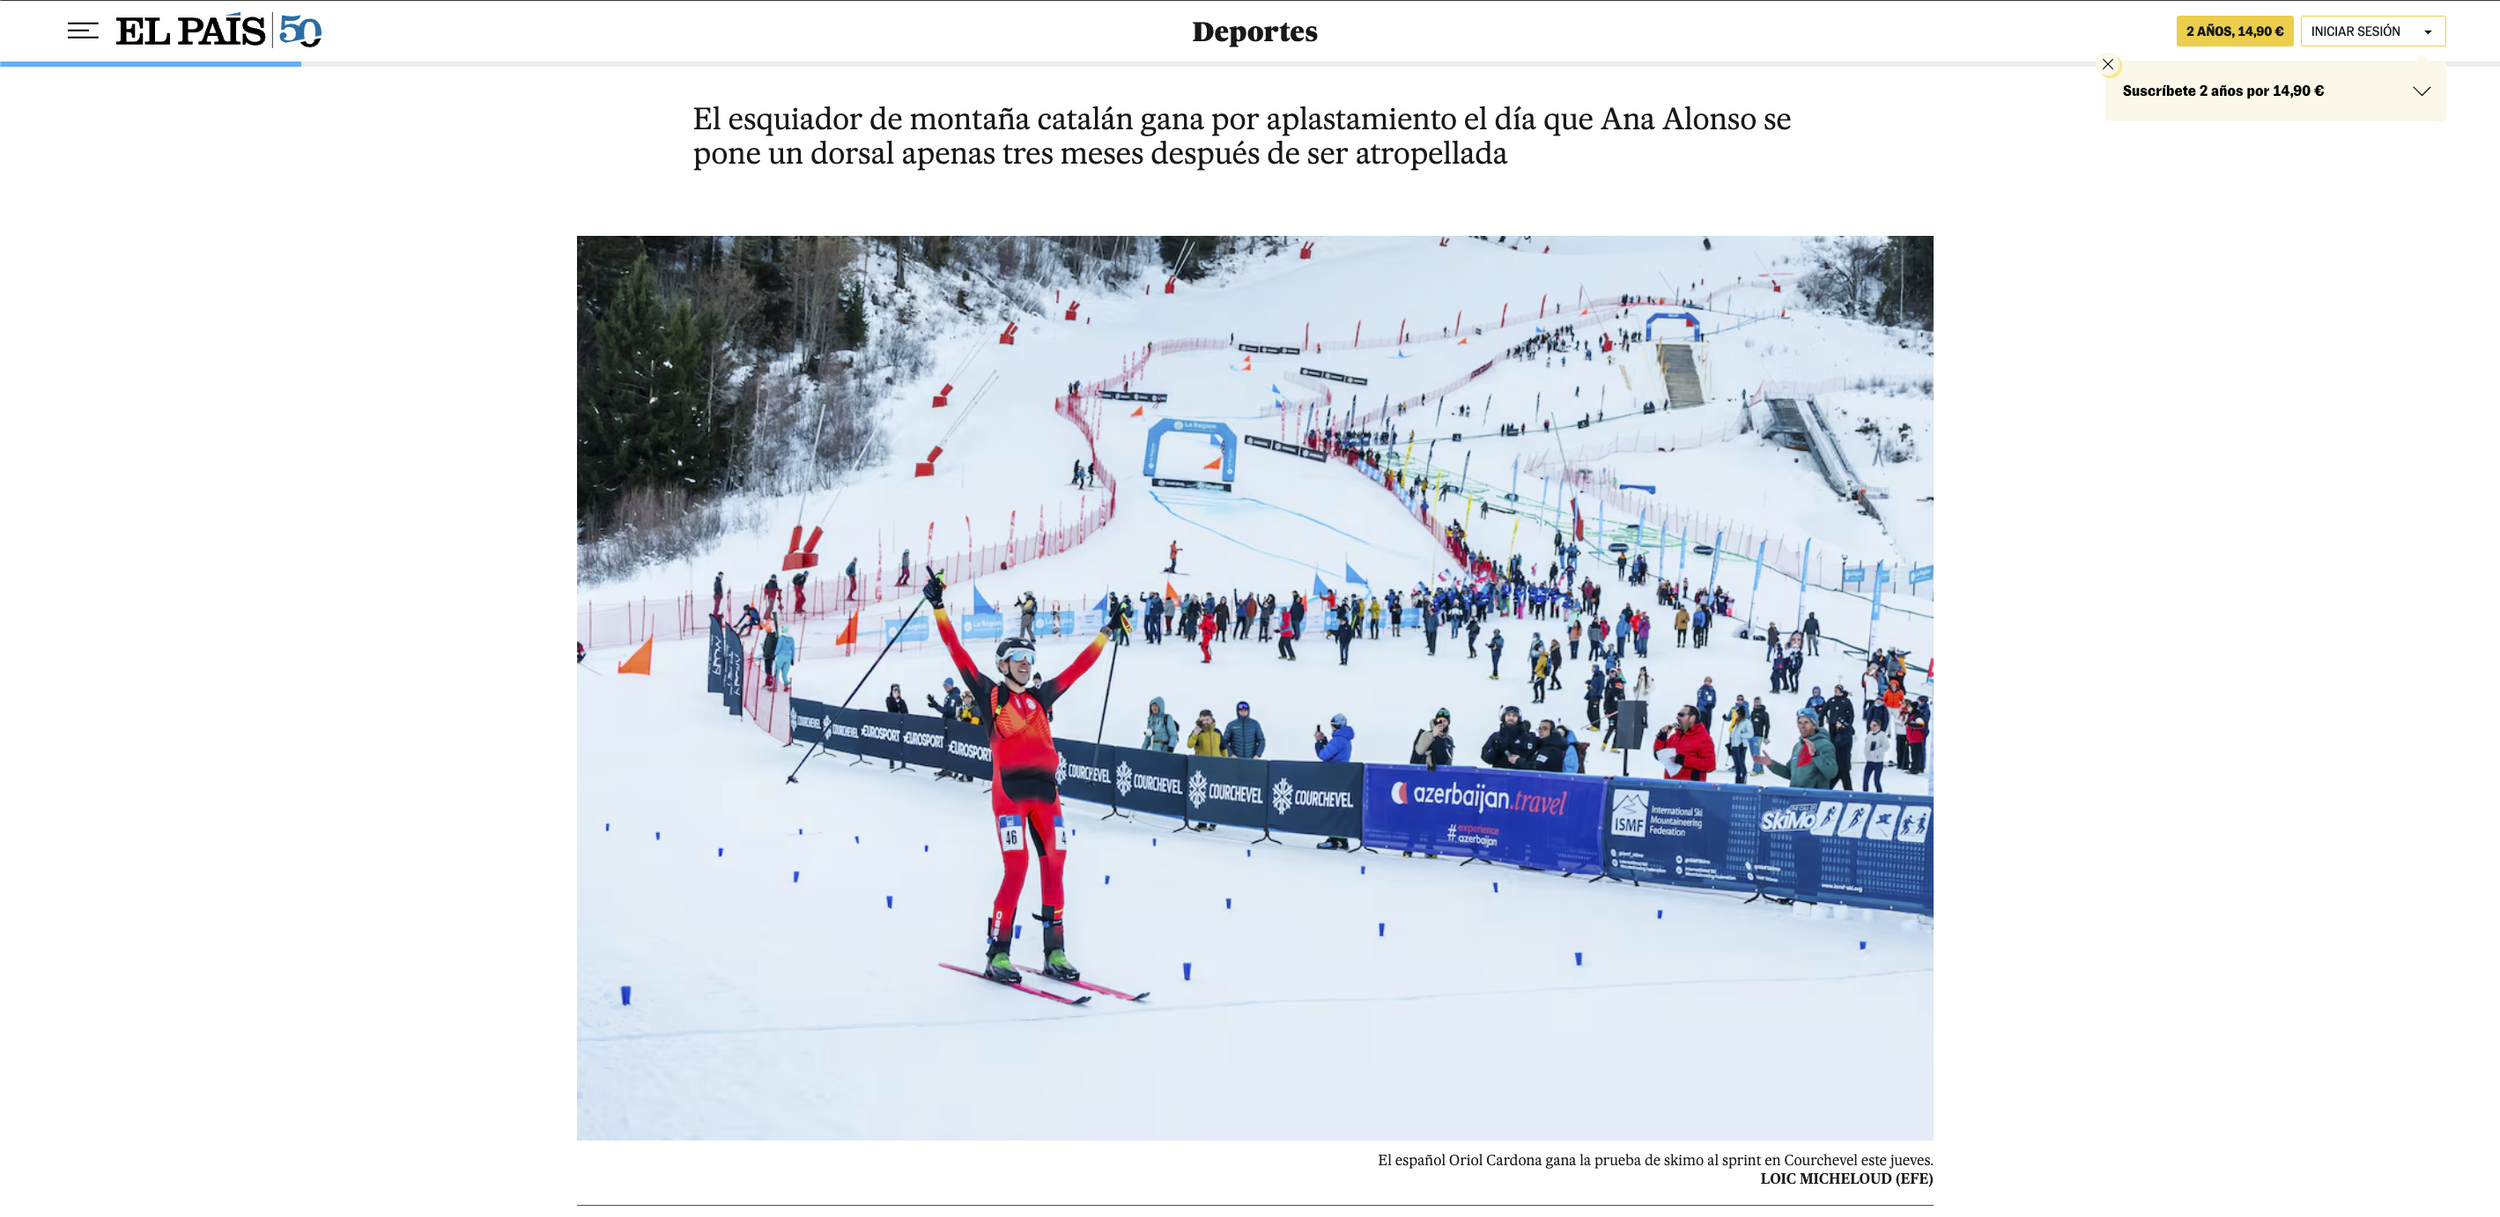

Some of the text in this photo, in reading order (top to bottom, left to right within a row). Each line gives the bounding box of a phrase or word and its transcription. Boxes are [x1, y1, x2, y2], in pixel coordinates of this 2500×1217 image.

[862, 725, 901, 743] EUROSPORT
[904, 731, 944, 749] EUROSPORT
[950, 740, 992, 762] EUROSPORT
[1133, 774, 1183, 795] COURCHEVEL
[1208, 783, 1263, 804] COURCHEVEL
[1294, 790, 1354, 808] COURCHEVEL
[1651, 805, 1703, 817] International Ski
[1615, 817, 1644, 833] ISMF
[1649, 825, 1686, 837] Federation
[1650, 815, 1702, 830] Mountaineering
[1006, 829, 1018, 845] 46
[1458, 833, 1498, 848] azerbaijan
